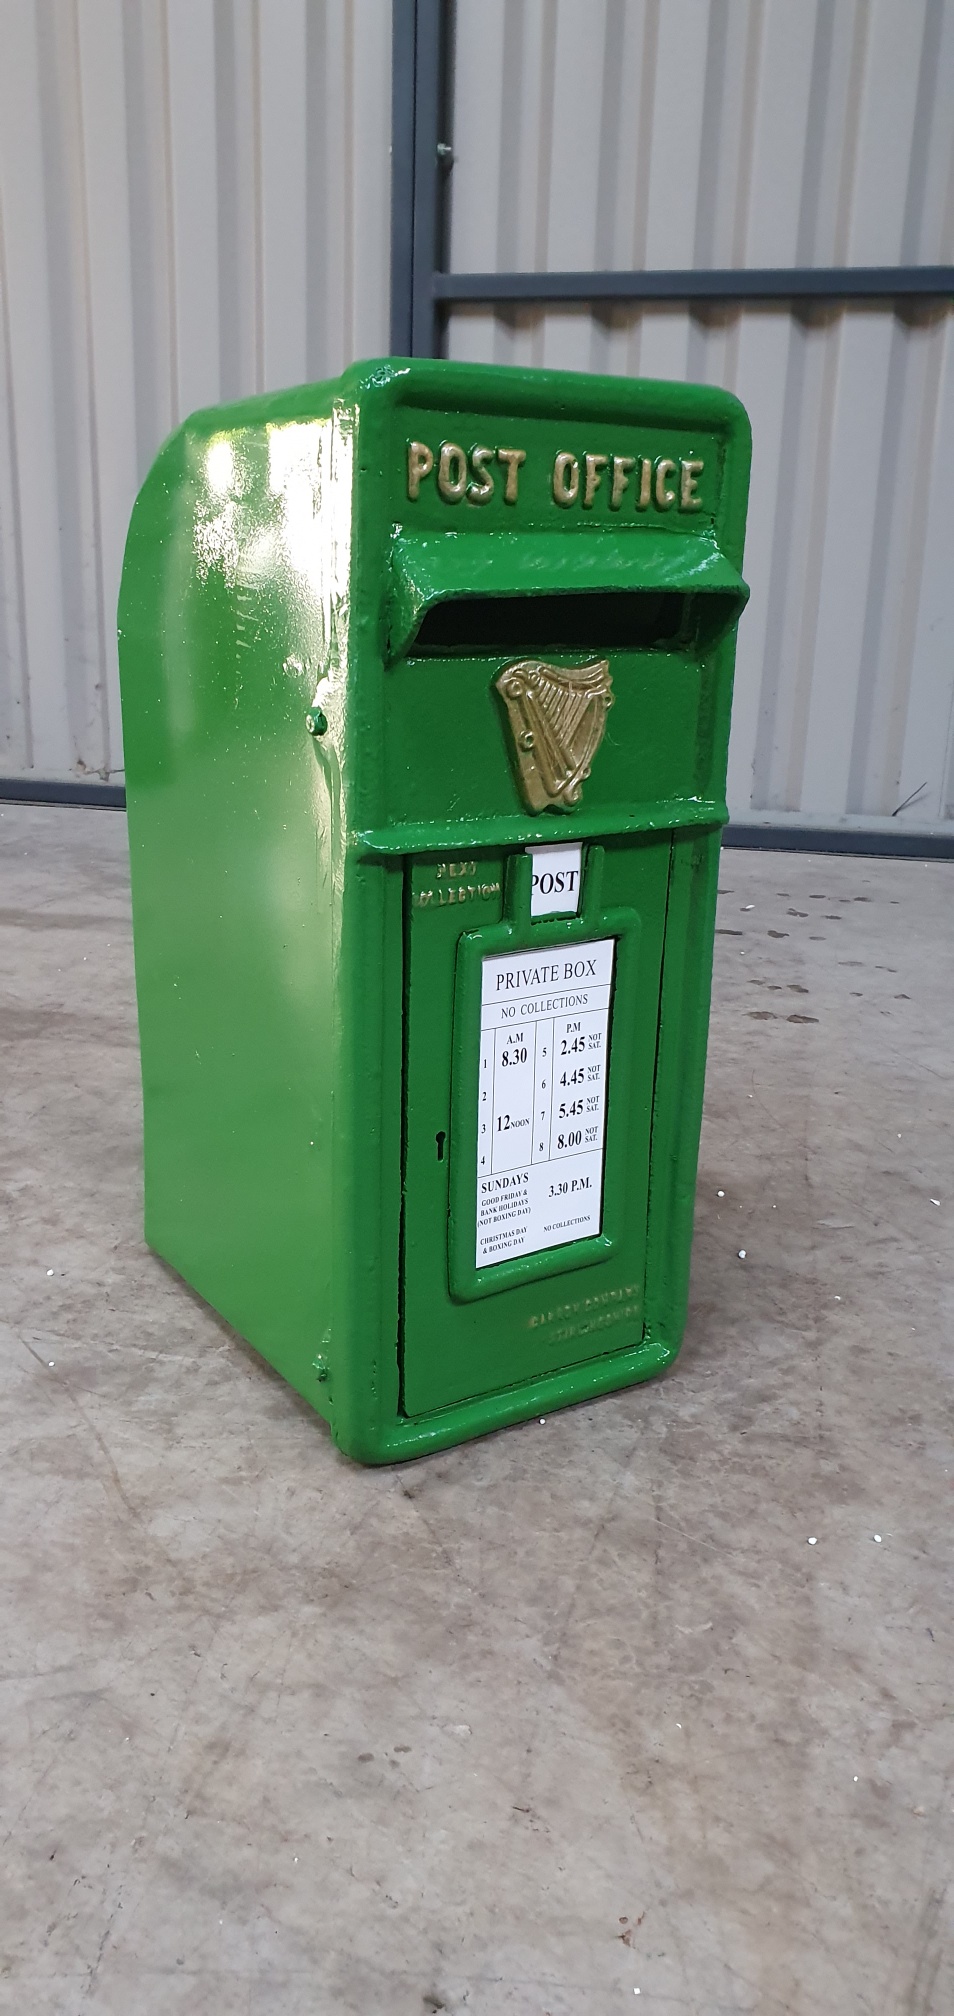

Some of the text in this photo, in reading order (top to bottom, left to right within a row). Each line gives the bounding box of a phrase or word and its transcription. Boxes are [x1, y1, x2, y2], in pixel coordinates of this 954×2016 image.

[408, 440, 704, 513] POST OFFICE
[496, 960, 597, 991] PRIVATE BOX
[501, 994, 588, 1019] NO COLLECTIONS
[566, 1022, 581, 1033] P.M
[506, 1032, 524, 1044] A.M
[588, 1041, 601, 1049] SAT.
[542, 1036, 585, 1057] 5 2.45
[502, 1047, 527, 1067] 8.30
[587, 1065, 600, 1073] NOT
[541, 1068, 584, 1089] 6 4.45
[587, 1073, 600, 1081] SAT.
[482, 1091, 486, 1101] 2
[586, 1096, 600, 1104] NOT
[541, 1100, 583, 1120] 7 5.45
[586, 1104, 599, 1112] SAT.
[481, 1124, 486, 1134] 3
[585, 1126, 598, 1135] NOT
[539, 1130, 582, 1152] 8 8.00
[585, 1134, 598, 1142] SAT.
[481, 1156, 485, 1165] 4
[481, 1172, 529, 1193] SUNDAYS
[548, 1177, 592, 1198] 3.30 P.M.
[481, 1197, 499, 1206] GOOD
[501, 1191, 522, 1201] FRIDAY
[481, 1198, 529, 1216] BANK HOLIDAYS
[477, 1207, 531, 1228] (NOT BOXING DAY)
[552, 1215, 590, 1230] COLLECTIONS
[480, 1226, 527, 1245] CHRISTMAS DAY
[489, 1241, 512, 1252] BOXING
[514, 1237, 525, 1245] DAY
